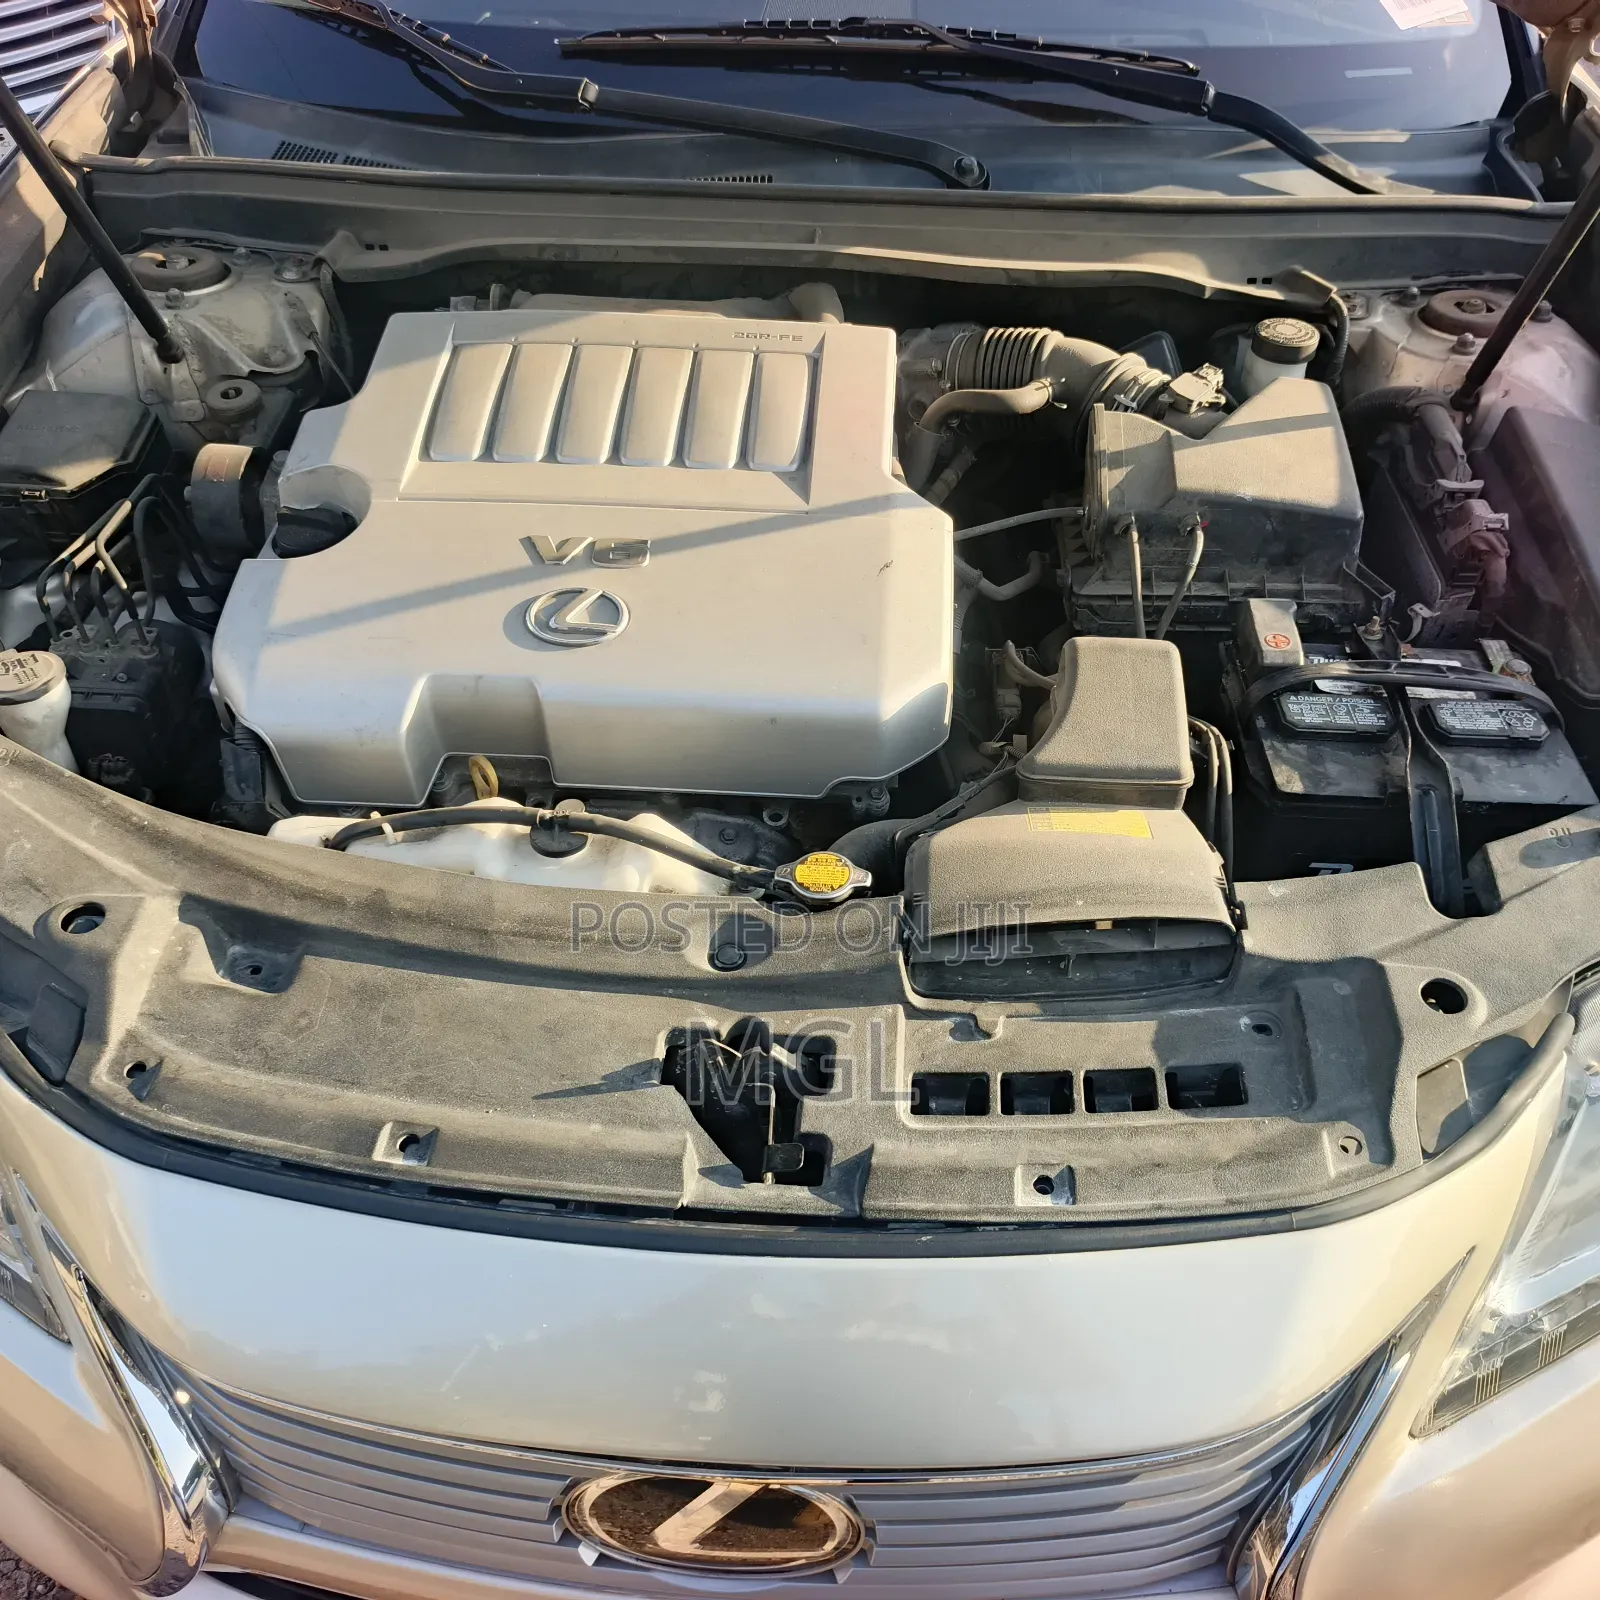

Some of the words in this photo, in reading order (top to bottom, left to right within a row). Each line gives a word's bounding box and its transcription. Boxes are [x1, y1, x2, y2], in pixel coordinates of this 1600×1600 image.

[732, 332, 803, 342] 2GR-FE
[521, 535, 650, 569] V6
[1298, 695, 1333, 703] DANGER
